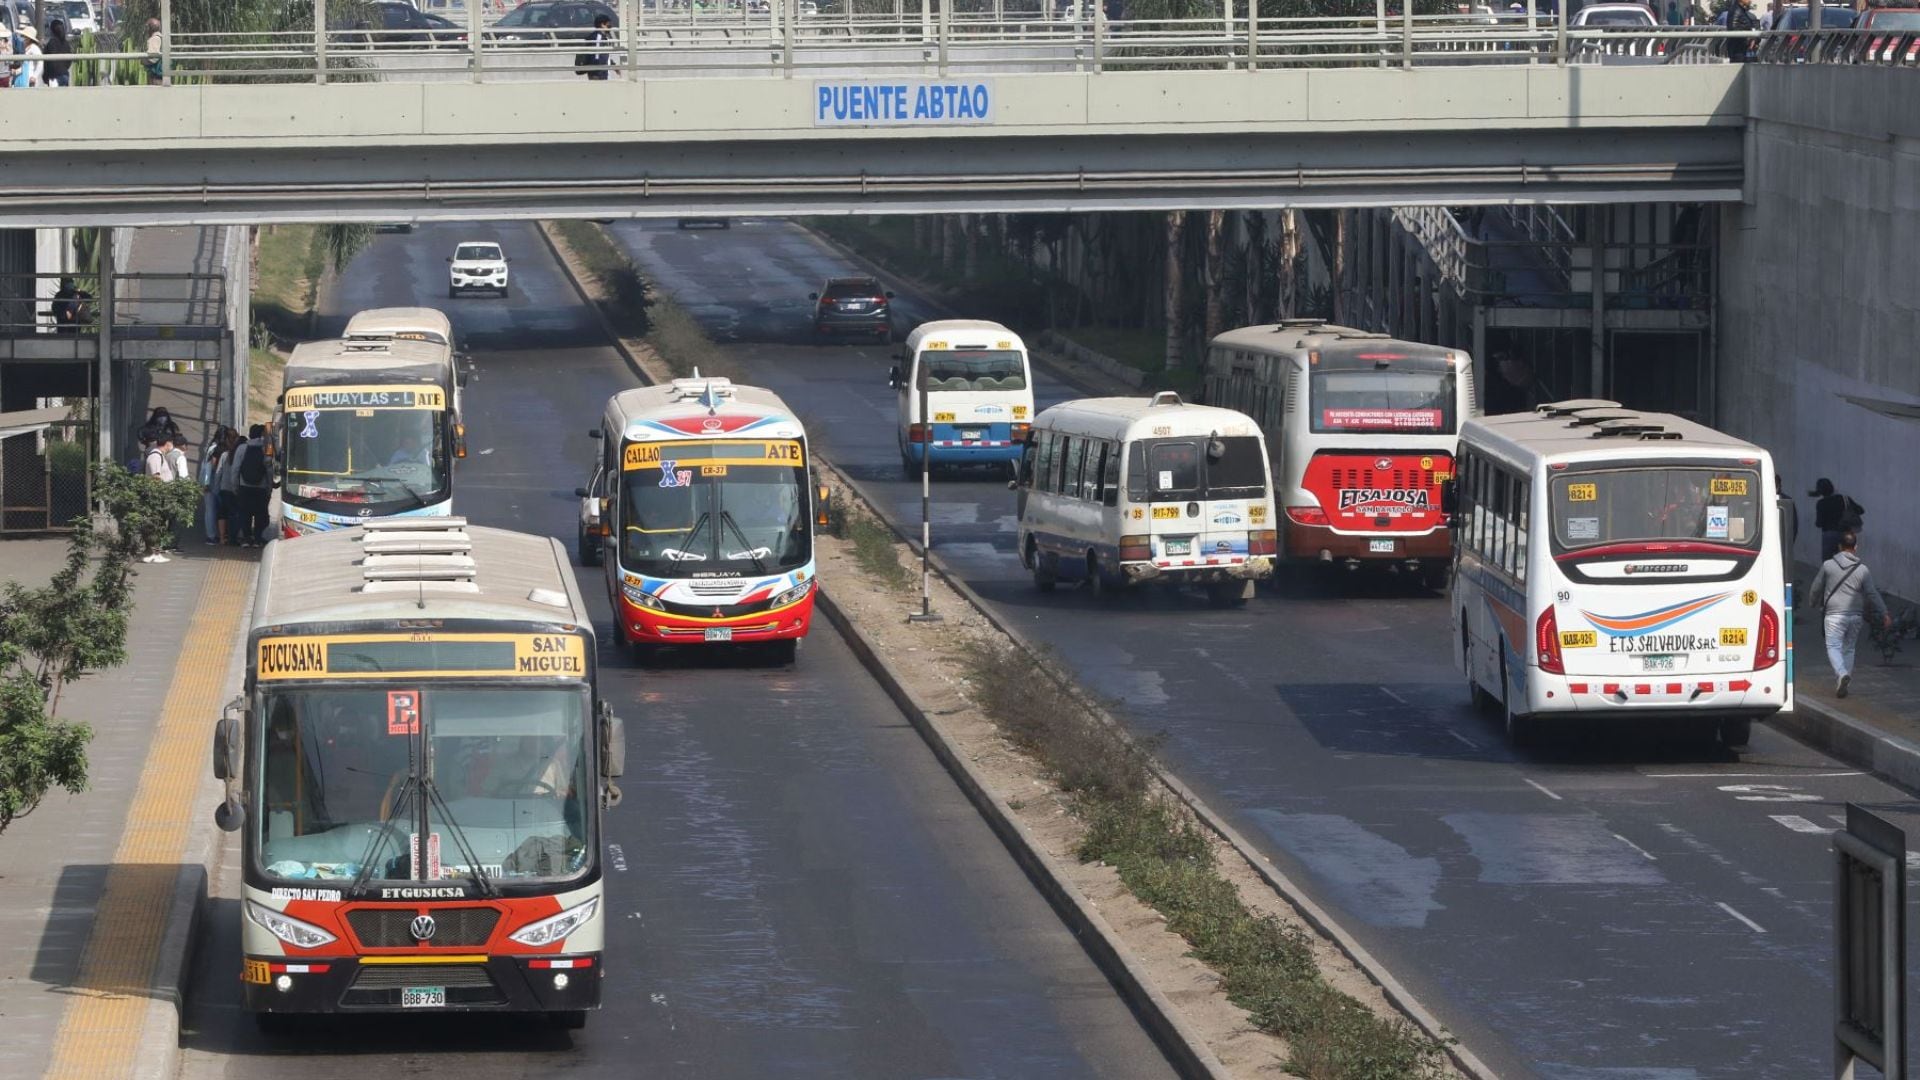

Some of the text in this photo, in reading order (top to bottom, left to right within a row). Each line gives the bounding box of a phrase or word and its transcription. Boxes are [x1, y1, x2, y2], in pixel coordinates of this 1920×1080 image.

[818, 84, 989, 120] PUENTE ABTAO
[287, 393, 313, 408] CALLAO
[418, 393, 440, 406] ATE
[626, 447, 659, 464] CALLAO
[767, 445, 800, 460] ATE
[703, 466, 725, 475] CR-37
[1339, 488, 1429, 510] ETSAJOSA
[1571, 489, 1592, 500] 8214
[1557, 591, 1570, 600] 90
[532, 637, 566, 652] SAN
[1723, 633, 1745, 644] 8214
[261, 643, 323, 673] PUCUSANA
[519, 656, 581, 673] MIGUEL
[271, 887, 341, 903] DIRECTO SAN PEDRO
[382, 887, 465, 899] ETGUSICSA
[403, 993, 443, 1005] BBB-730
